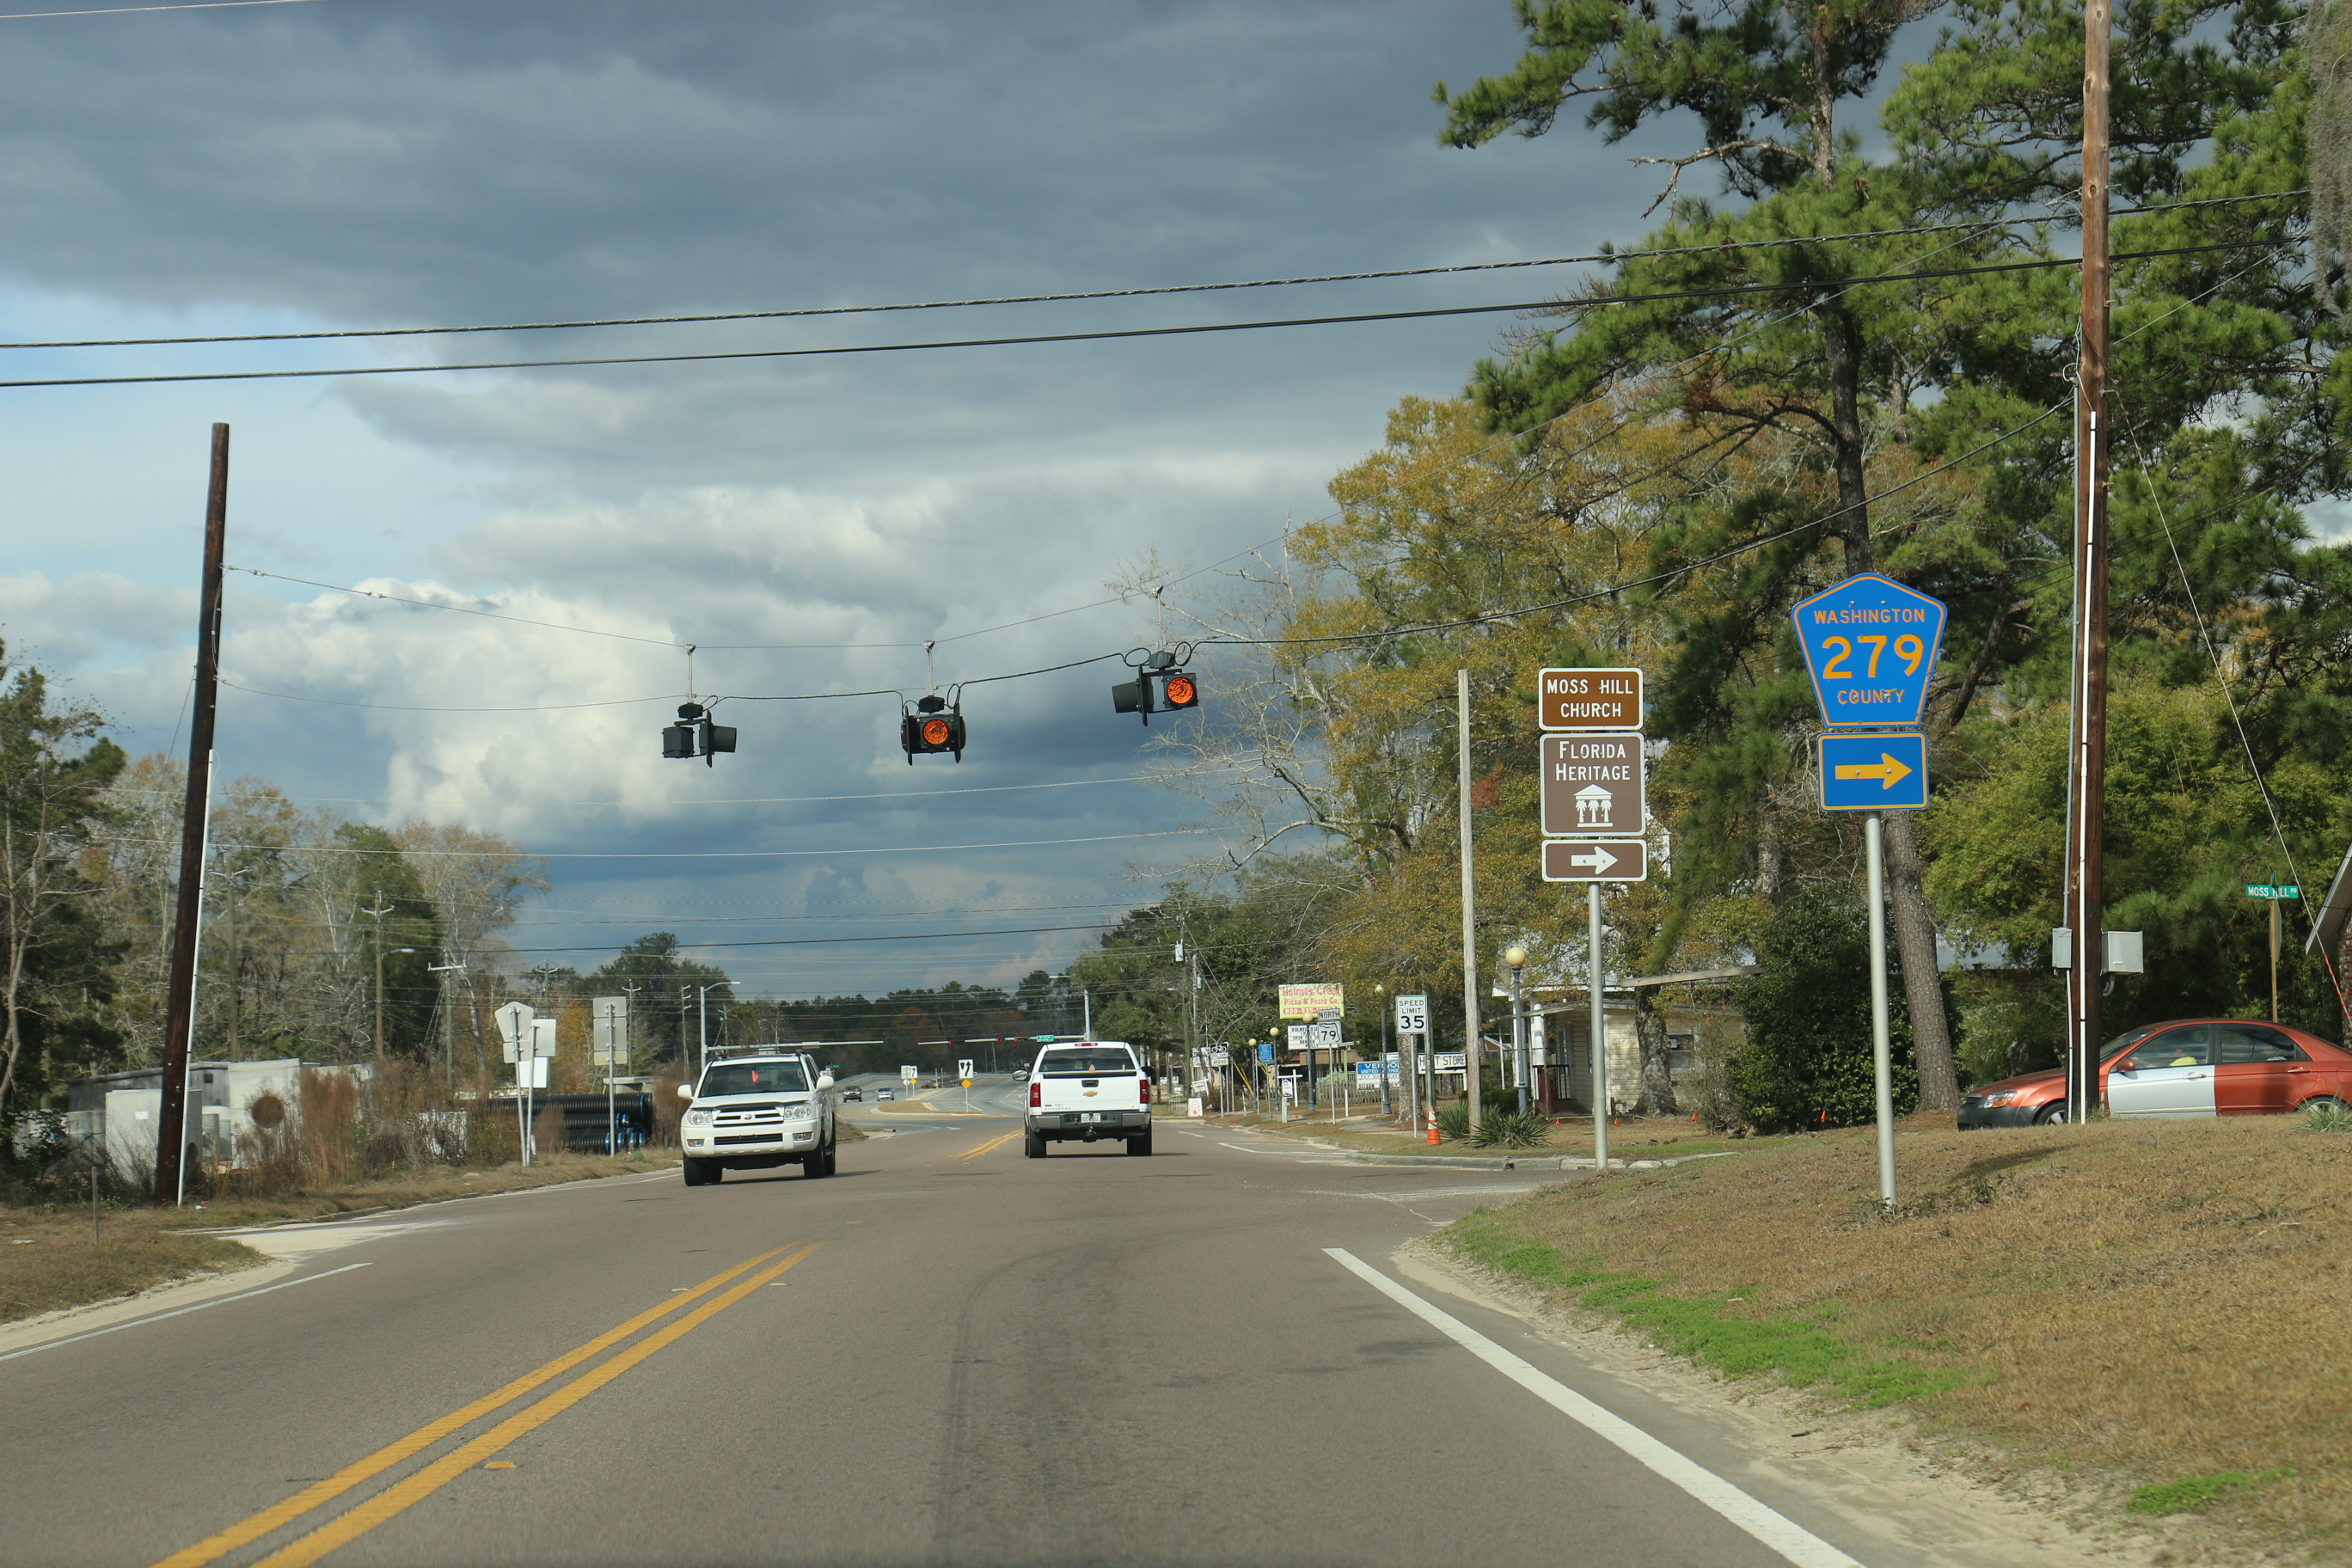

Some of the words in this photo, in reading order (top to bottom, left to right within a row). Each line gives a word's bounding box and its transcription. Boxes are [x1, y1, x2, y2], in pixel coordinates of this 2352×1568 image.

[1814, 608, 1926, 624] WASHINGTON
[1822, 634, 1924, 679] 279
[1547, 678, 1589, 695] MOSS
[1600, 678, 1633, 695] HILL
[1837, 689, 1905, 705] COUNTY
[1560, 702, 1621, 718] CHURCH
[1559, 740, 1626, 759] FLORIDA
[1555, 763, 1631, 781] HERITAGE
[2248, 886, 2269, 897] MOSS
[2272, 887, 2289, 897] HILL
[1282, 986, 1314, 996] Holmes
[1319, 1011, 1340, 1020] NORTH
[1400, 1015, 1424, 1029] 35
[1320, 1030, 1337, 1042] 79
[1443, 1055, 1465, 1066] STORE
